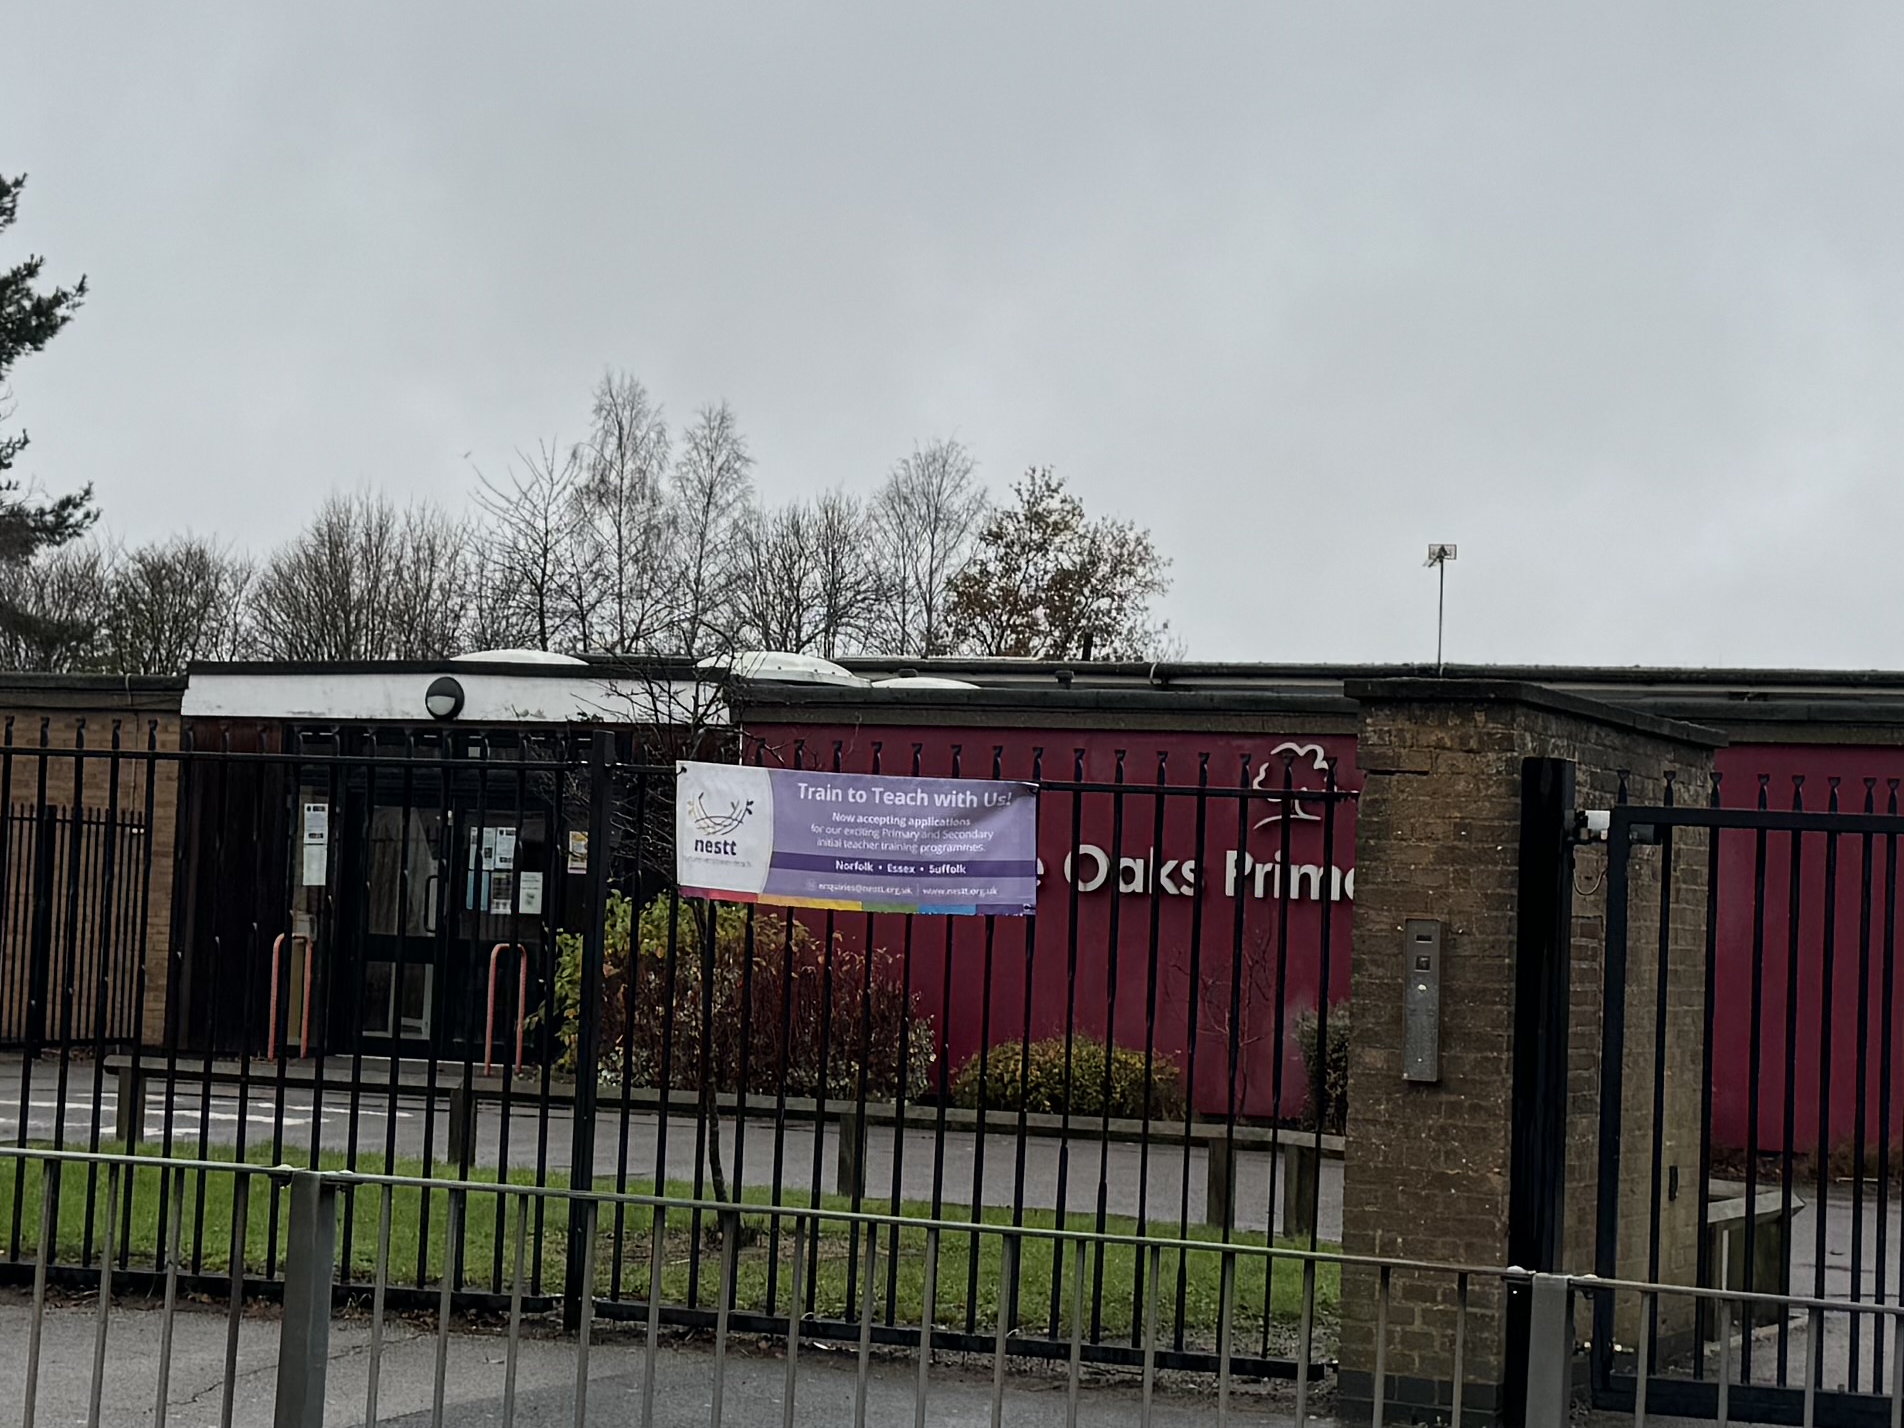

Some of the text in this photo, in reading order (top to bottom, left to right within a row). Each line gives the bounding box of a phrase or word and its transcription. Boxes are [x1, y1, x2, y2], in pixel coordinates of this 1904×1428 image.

[797, 782, 1012, 808] Train to Teach with Us!
[832, 811, 971, 829] Now accepting applications
[811, 824, 994, 841] for our exciting Primary and Secondary
[694, 838, 737, 856] nestt
[816, 837, 842, 848] initial
[843, 838, 879, 850] teacher
[880, 839, 918, 853] training
[835, 859, 967, 875] Norfolk Essex Suffolk
[1064, 844, 1196, 897] Oaks
